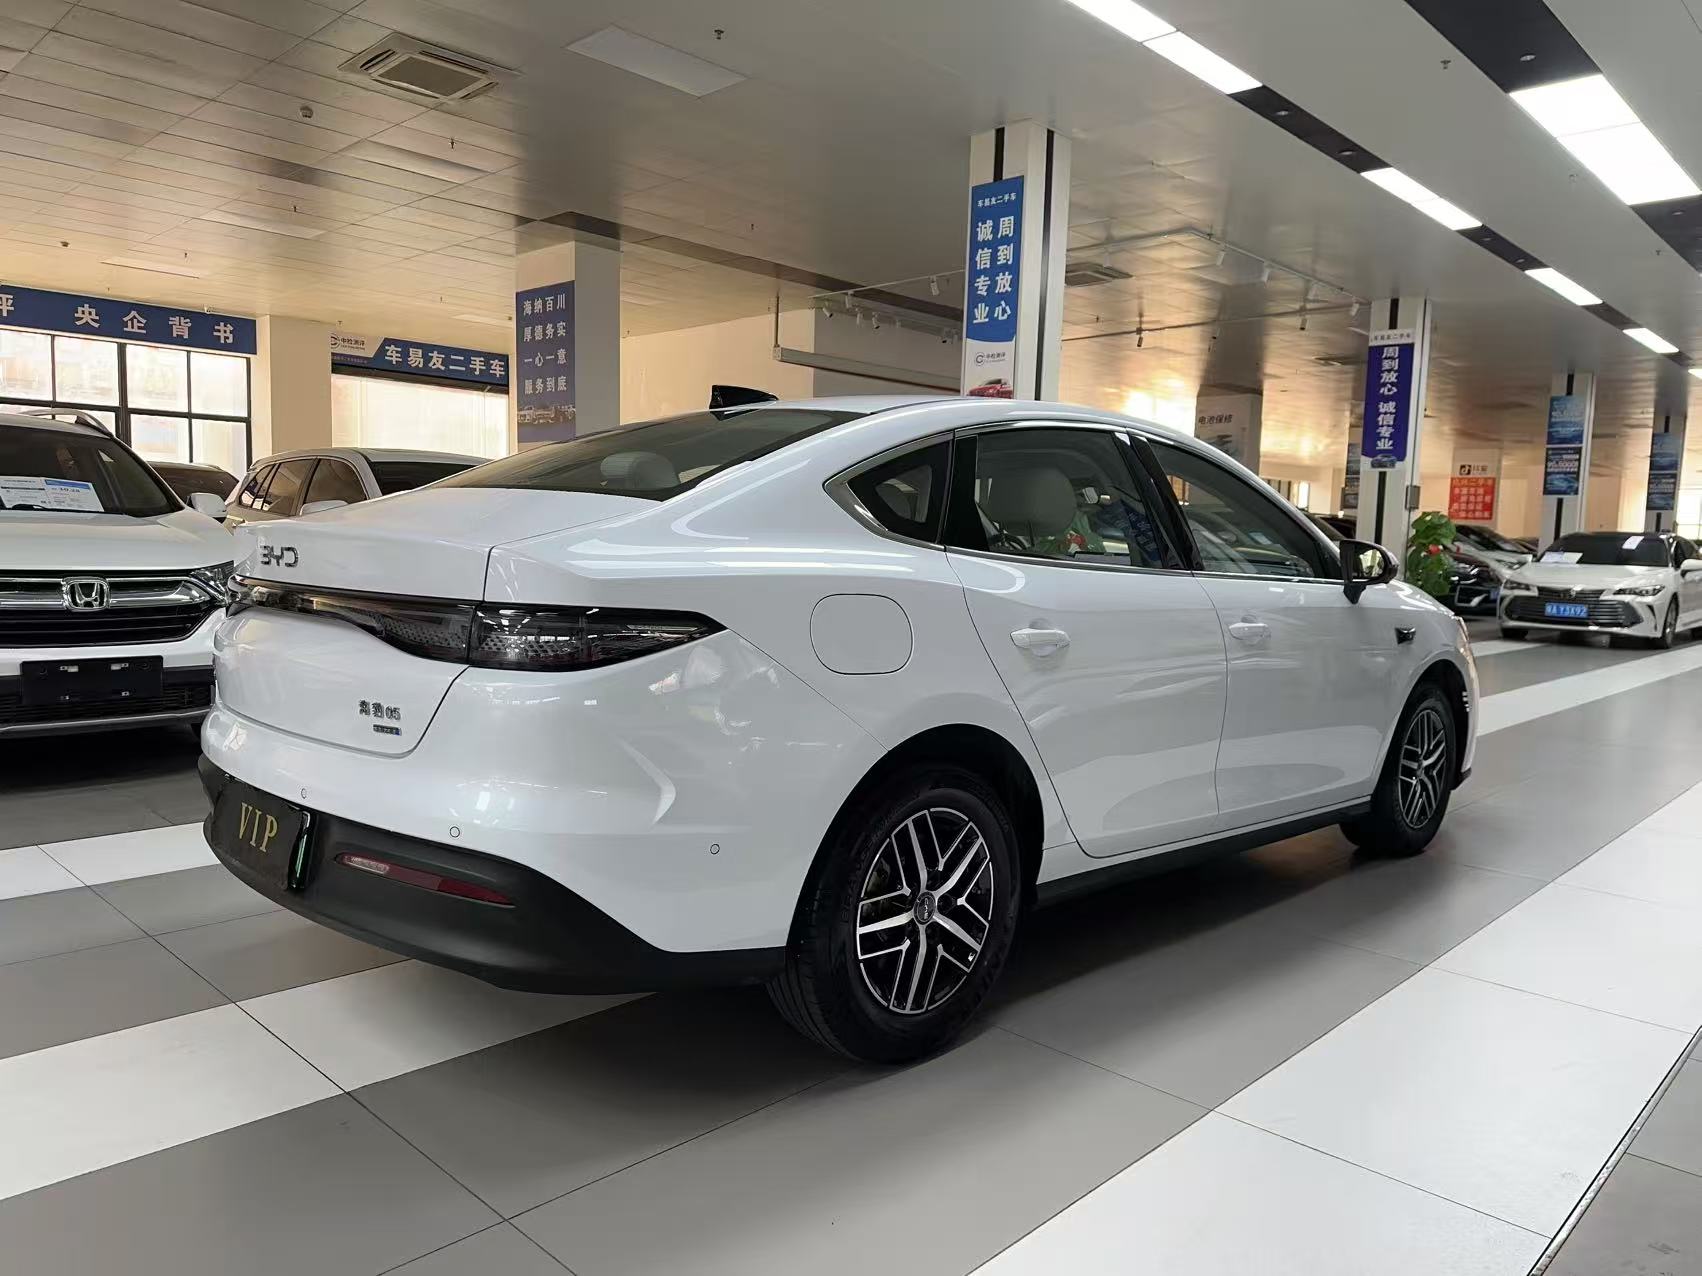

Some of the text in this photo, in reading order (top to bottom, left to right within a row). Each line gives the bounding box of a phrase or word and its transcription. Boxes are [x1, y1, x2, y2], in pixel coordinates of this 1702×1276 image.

[972, 220, 994, 324] 诚信专业
[993, 215, 1015, 321] 周到放心
[523, 292, 566, 316] 海纳百川
[74, 303, 235, 344] 央企背书
[523, 321, 567, 342] 厚德务实
[384, 344, 505, 378] 车易友二手车
[523, 348, 567, 367] 一心一意
[524, 376, 567, 395] 服务到底
[1375, 346, 1399, 450] 周到放心 诚信专业
[239, 802, 280, 853] VIP
